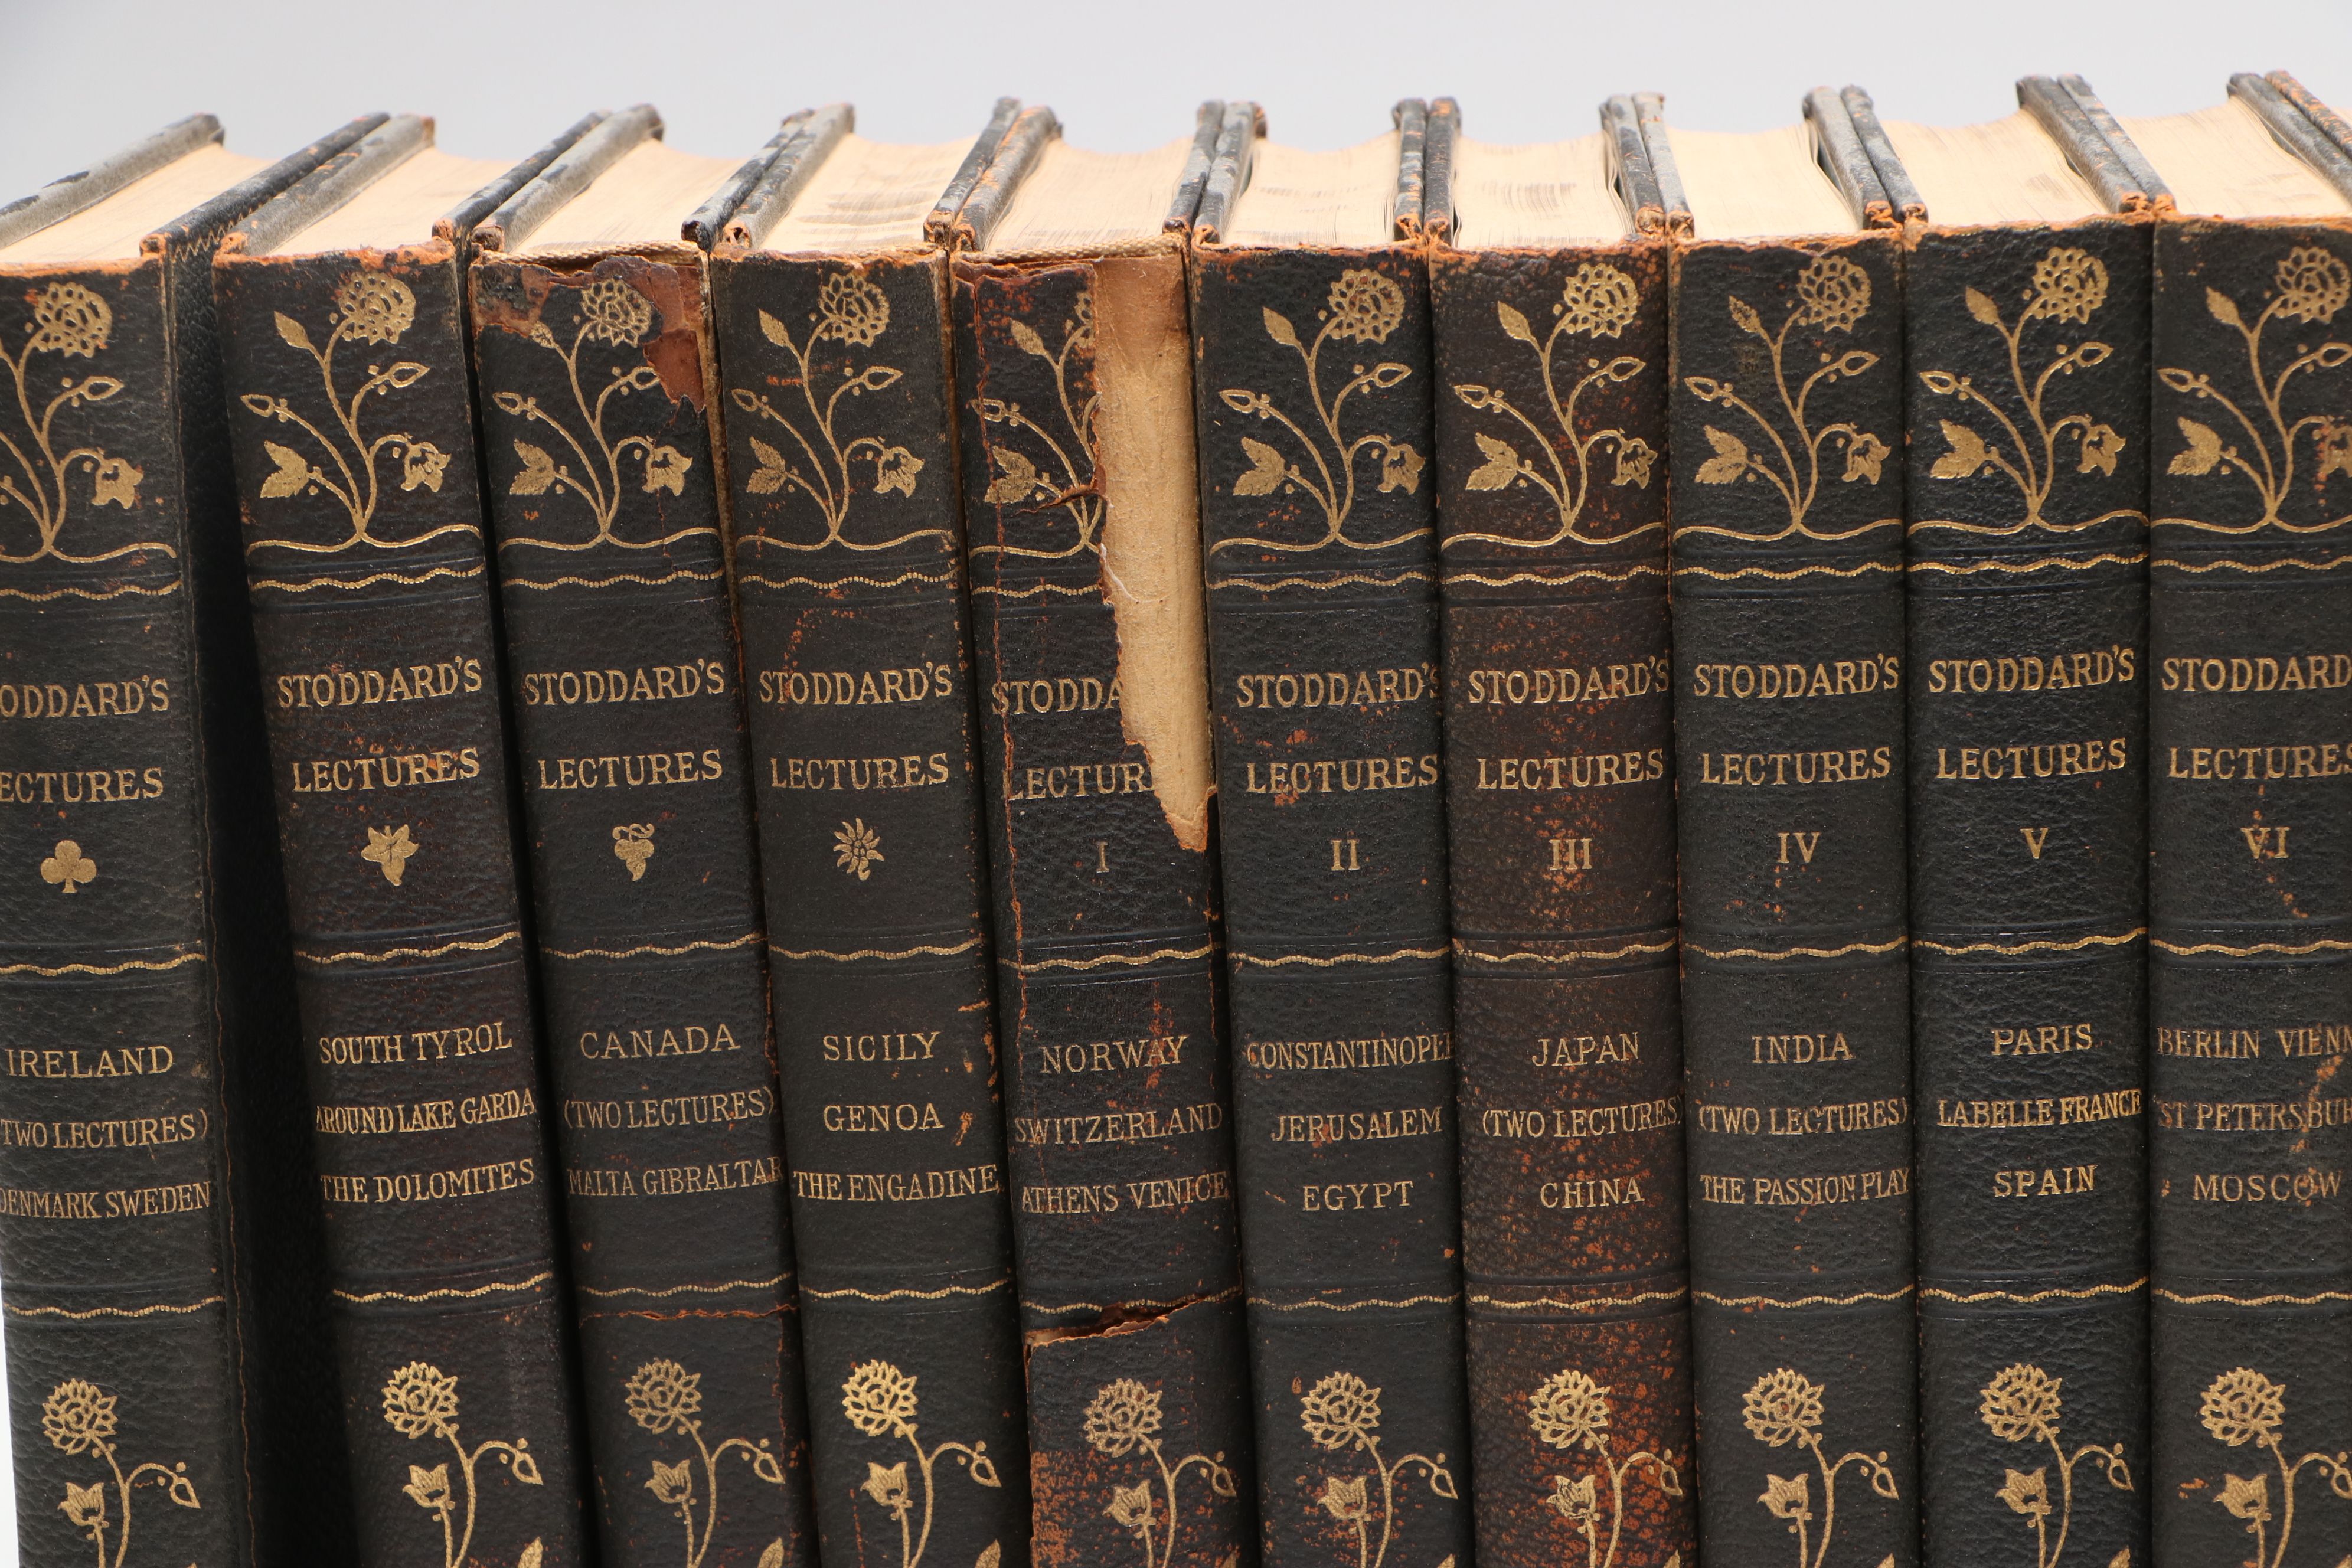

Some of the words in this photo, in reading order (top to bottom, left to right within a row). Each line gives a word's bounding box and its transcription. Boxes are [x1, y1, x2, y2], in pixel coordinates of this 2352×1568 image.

[277, 656, 482, 707] STODDARD'S
[525, 659, 724, 705] STODDARD'S
[760, 661, 952, 705] STODDARD'S
[1237, 662, 1439, 708] STODDARD'S
[1468, 655, 1670, 704] STODDARD'S
[1694, 653, 1899, 699] STODDARD'S
[1929, 645, 2134, 693] STODDARD'S
[2162, 654, 2352, 692] STODDARD
[0, 674, 169, 718] ODDARD'S
[992, 677, 1122, 714] STODDA
[293, 747, 480, 793] LECTURES
[538, 749, 723, 789] LECTURES
[771, 753, 949, 790] LECTURES
[1246, 755, 1438, 793] LECTURES
[1476, 748, 1664, 790] LECTURES
[1701, 746, 1890, 786] LECTURES
[1936, 737, 2126, 780] LECTURES
[0, 767, 164, 803] ECTURES
[1001, 762, 1155, 801] LECTUR
[1096, 842, 1109, 873] I
[1331, 839, 1360, 871] II
[1549, 838, 1593, 871] III
[1776, 831, 1820, 864] IV
[2020, 828, 2049, 860] V
[2240, 827, 2290, 859] VI
[319, 1034, 406, 1065] SOUTH
[412, 1021, 513, 1061] TYROL
[580, 1024, 741, 1059] CANADA
[823, 1031, 941, 1061] SICILY
[1040, 1035, 1188, 1074] NORWAY
[1531, 1031, 1639, 1067] JAPAN
[1752, 1033, 1856, 1063] INDIA
[1991, 1023, 2093, 1056] PARIS
[2157, 1027, 2259, 1059] BERLIN
[5, 1046, 173, 1078] IRELAND
[316, 1105, 394, 1134] AROUND
[396, 1100, 457, 1133] LAKE
[460, 1087, 537, 1125] GARDA
[564, 1100, 622, 1129] (TWO
[625, 1086, 775, 1129] LECTURES)
[824, 1103, 945, 1132] GENOA
[1014, 1102, 1223, 1145] SWITZERLAND
[1270, 1106, 1444, 1143] JERUSALEM
[1482, 1109, 1546, 1138] (TWO
[1698, 1105, 1760, 1136] (TWO
[1768, 1097, 1909, 1136] LECTURES)
[2059, 1089, 2142, 1125] FRANCE
[53, 1108, 208, 1148] LECTURES)
[320, 1174, 368, 1203] THE
[373, 1158, 535, 1203] DOLOMITES
[566, 1168, 638, 1197] MALTA
[642, 1156, 784, 1196] GIBRALTAR
[793, 1171, 843, 1200] THE
[847, 1164, 1000, 1201] ENGADINE
[1021, 1184, 1119, 1214] ATHENS
[1126, 1171, 1229, 1209] VENICE
[1540, 1178, 1645, 1208] CHINA
[1700, 1174, 1745, 1204] THE
[1753, 1174, 1857, 1206] PASSION
[1860, 1167, 1910, 1200] PLAY
[1993, 1164, 2098, 1197] SPAIN
[2193, 1170, 2341, 1202] MOSCOW
[105, 1182, 213, 1217] SWEDEN
[1302, 1181, 1415, 1211] EGYPT
